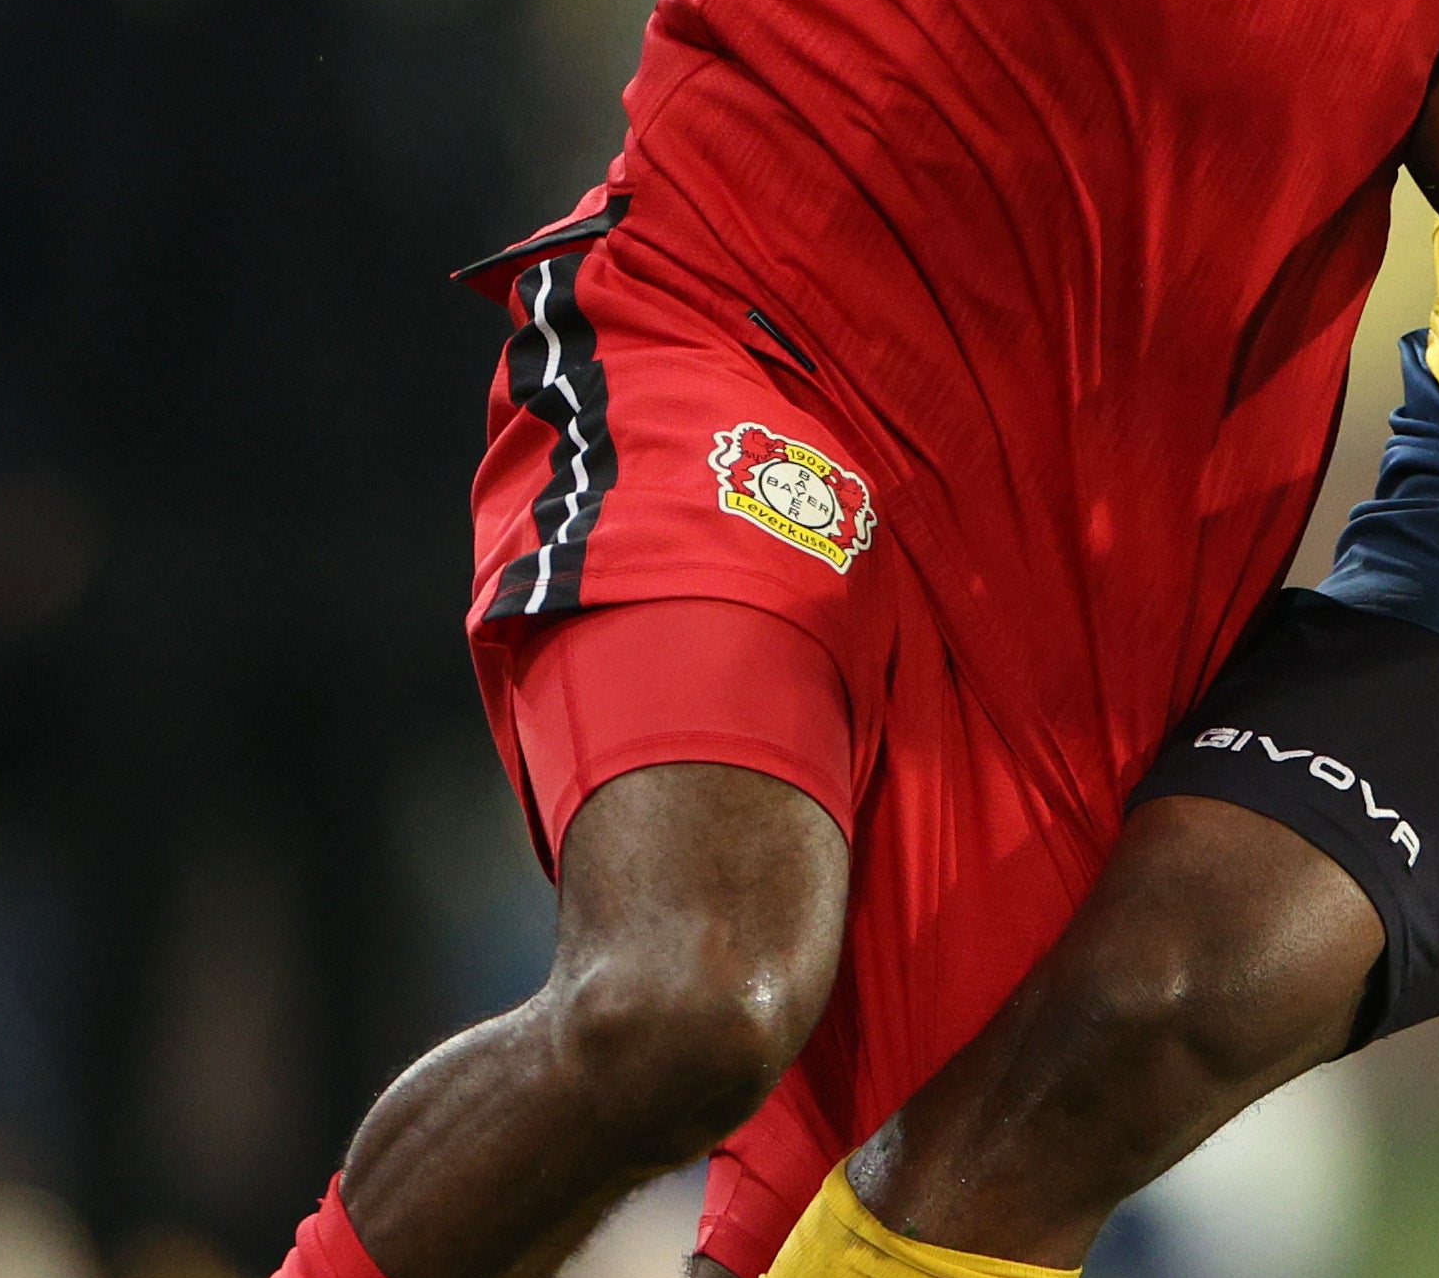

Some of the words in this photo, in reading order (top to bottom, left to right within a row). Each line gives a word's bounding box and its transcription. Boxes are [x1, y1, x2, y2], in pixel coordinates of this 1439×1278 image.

[788, 446, 828, 475] 1904
[766, 475, 830, 516] BAYER
[787, 468, 812, 520] BAYER
[735, 495, 839, 559] Leverkusen
[1192, 726, 1422, 869] GIVOVA
